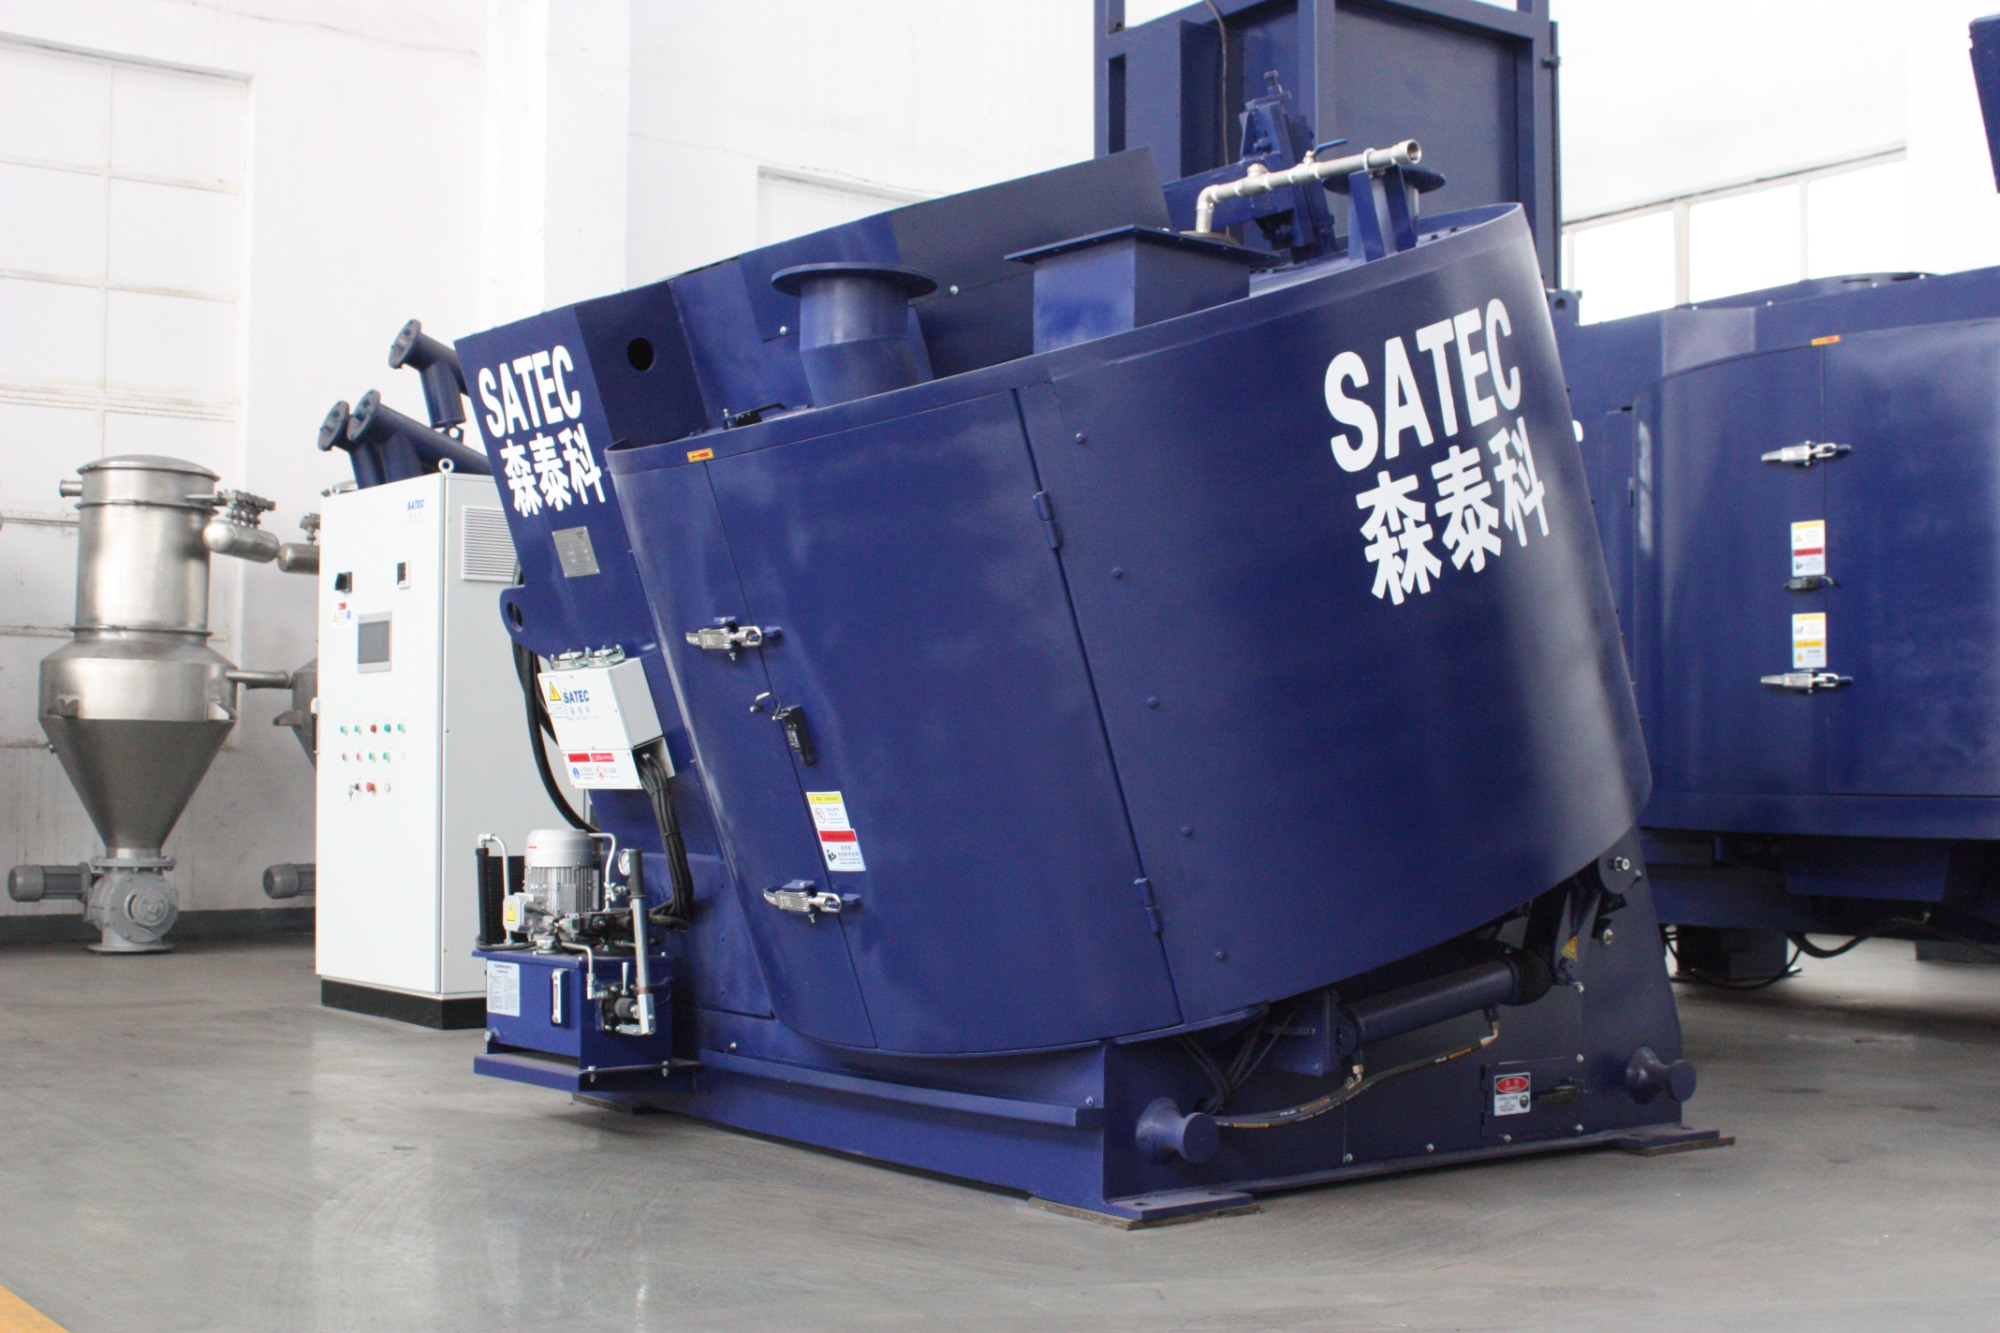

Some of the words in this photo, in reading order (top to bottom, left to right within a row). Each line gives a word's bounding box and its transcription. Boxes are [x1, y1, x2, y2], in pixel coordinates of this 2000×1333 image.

[478, 345, 582, 438] SATEC
[1325, 298, 1521, 473] SATEC
[500, 423, 606, 518] 森泰科
[1355, 416, 1549, 605] 森泰科
[563, 689, 590, 704] SATEC
